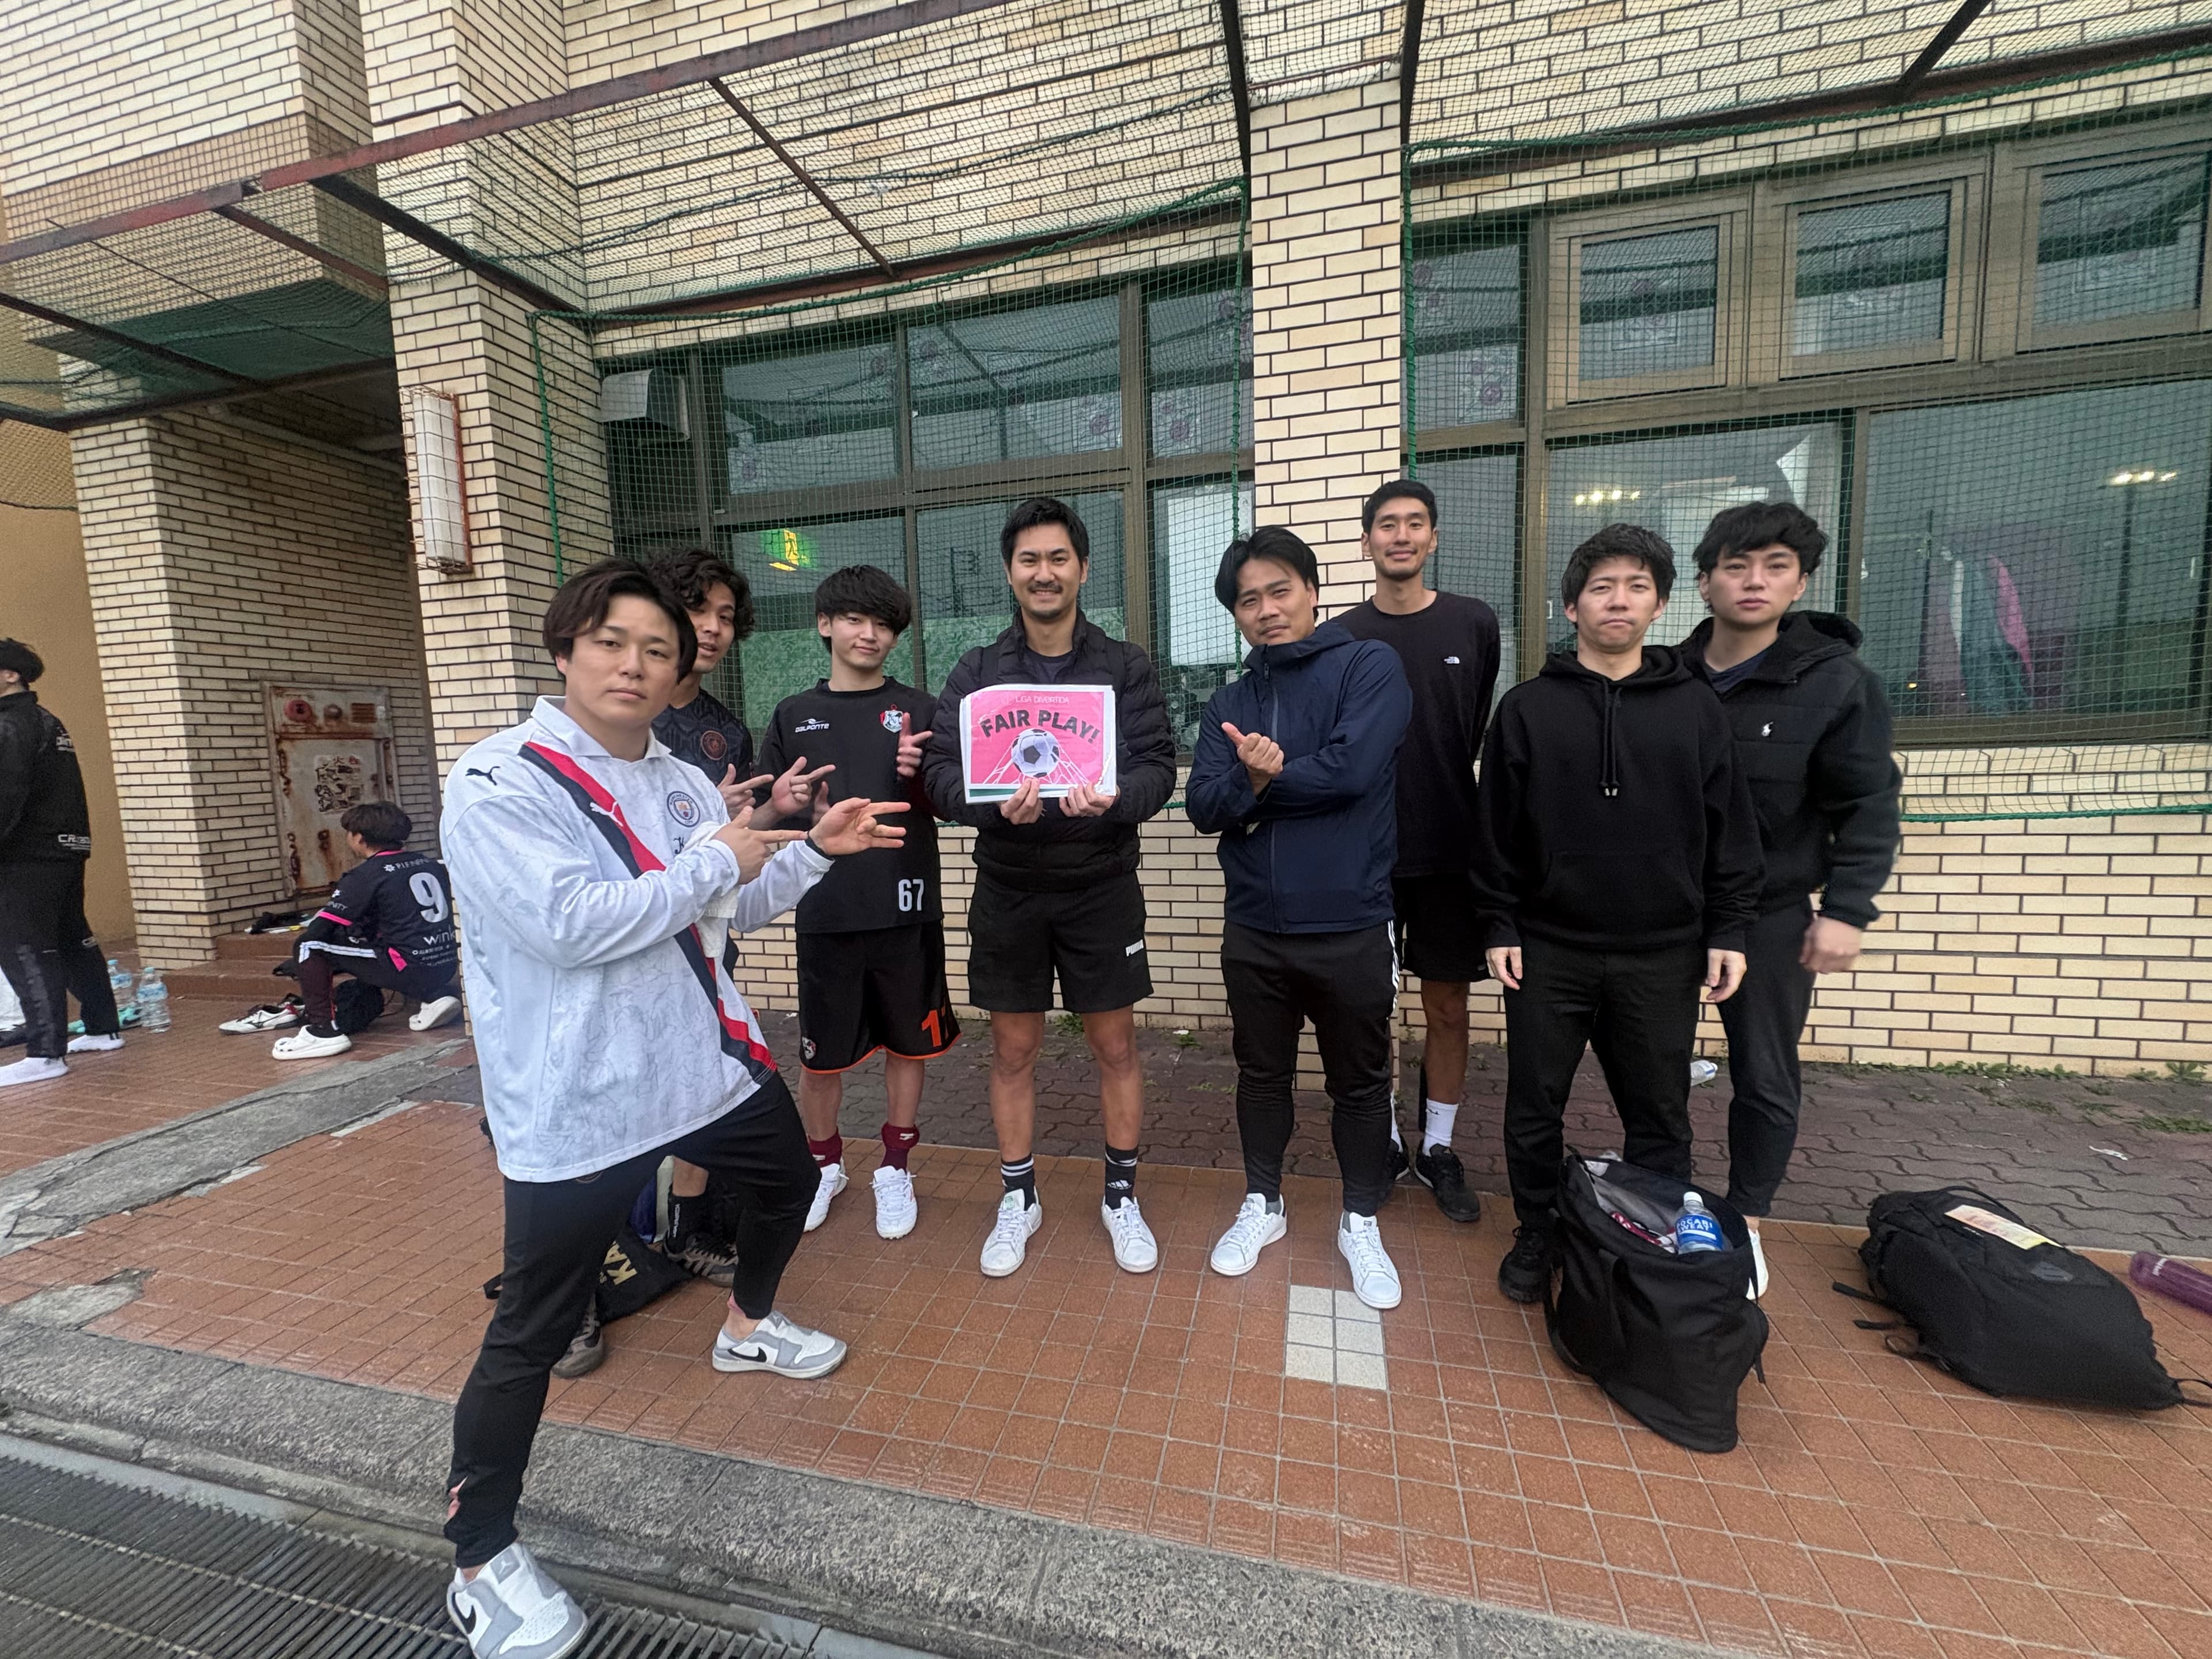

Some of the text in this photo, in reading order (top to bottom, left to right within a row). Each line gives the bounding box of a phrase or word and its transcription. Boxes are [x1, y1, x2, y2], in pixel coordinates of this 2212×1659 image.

[1033, 696, 1069, 704] DIVERTIDA
[980, 710, 1100, 744] FAIR PLAY!
[410, 872, 449, 923] 9
[899, 879, 924, 911] 67
[1126, 940, 1143, 957] PUMA
